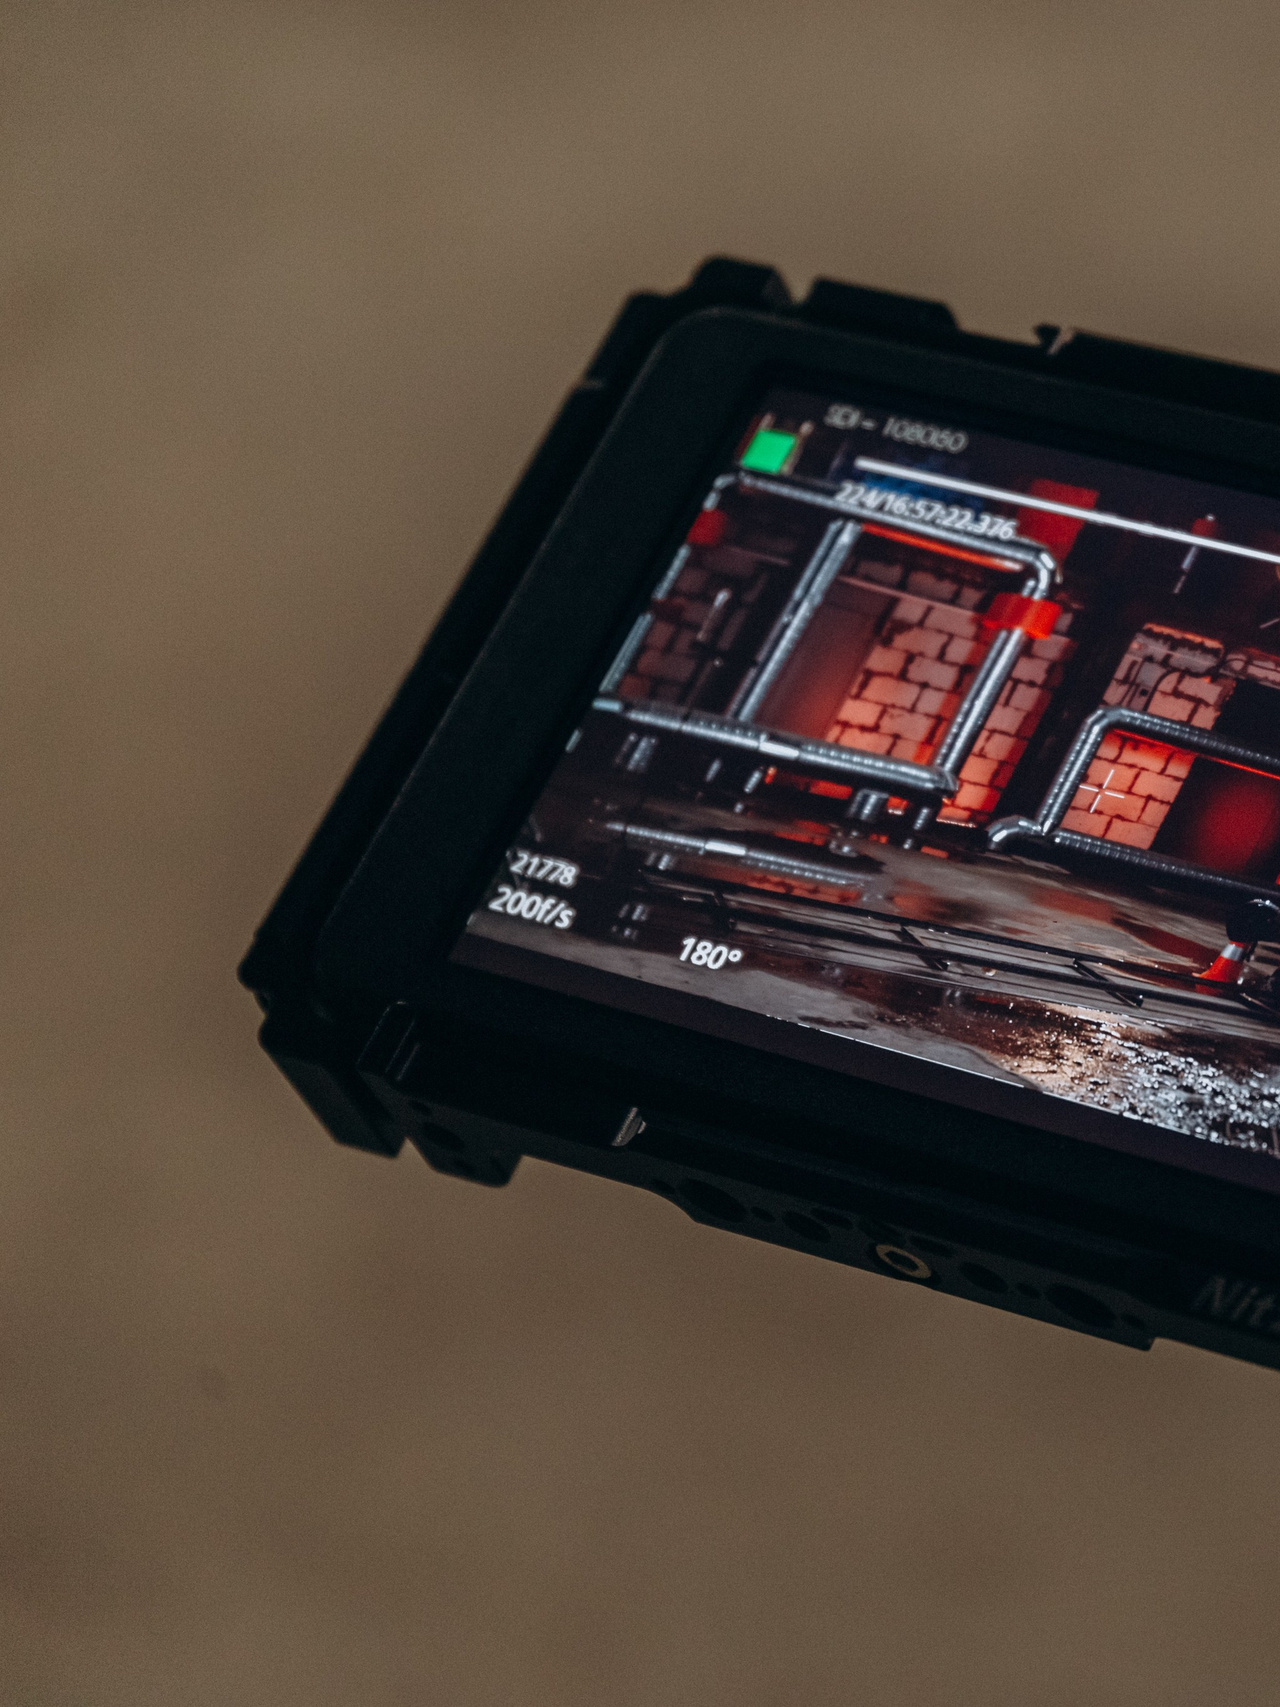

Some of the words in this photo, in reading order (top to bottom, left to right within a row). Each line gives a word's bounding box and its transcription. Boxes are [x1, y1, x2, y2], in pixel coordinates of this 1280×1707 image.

[509, 849, 580, 888] 21778
[488, 885, 577, 929] 200f/s
[679, 936, 743, 970] 180°
